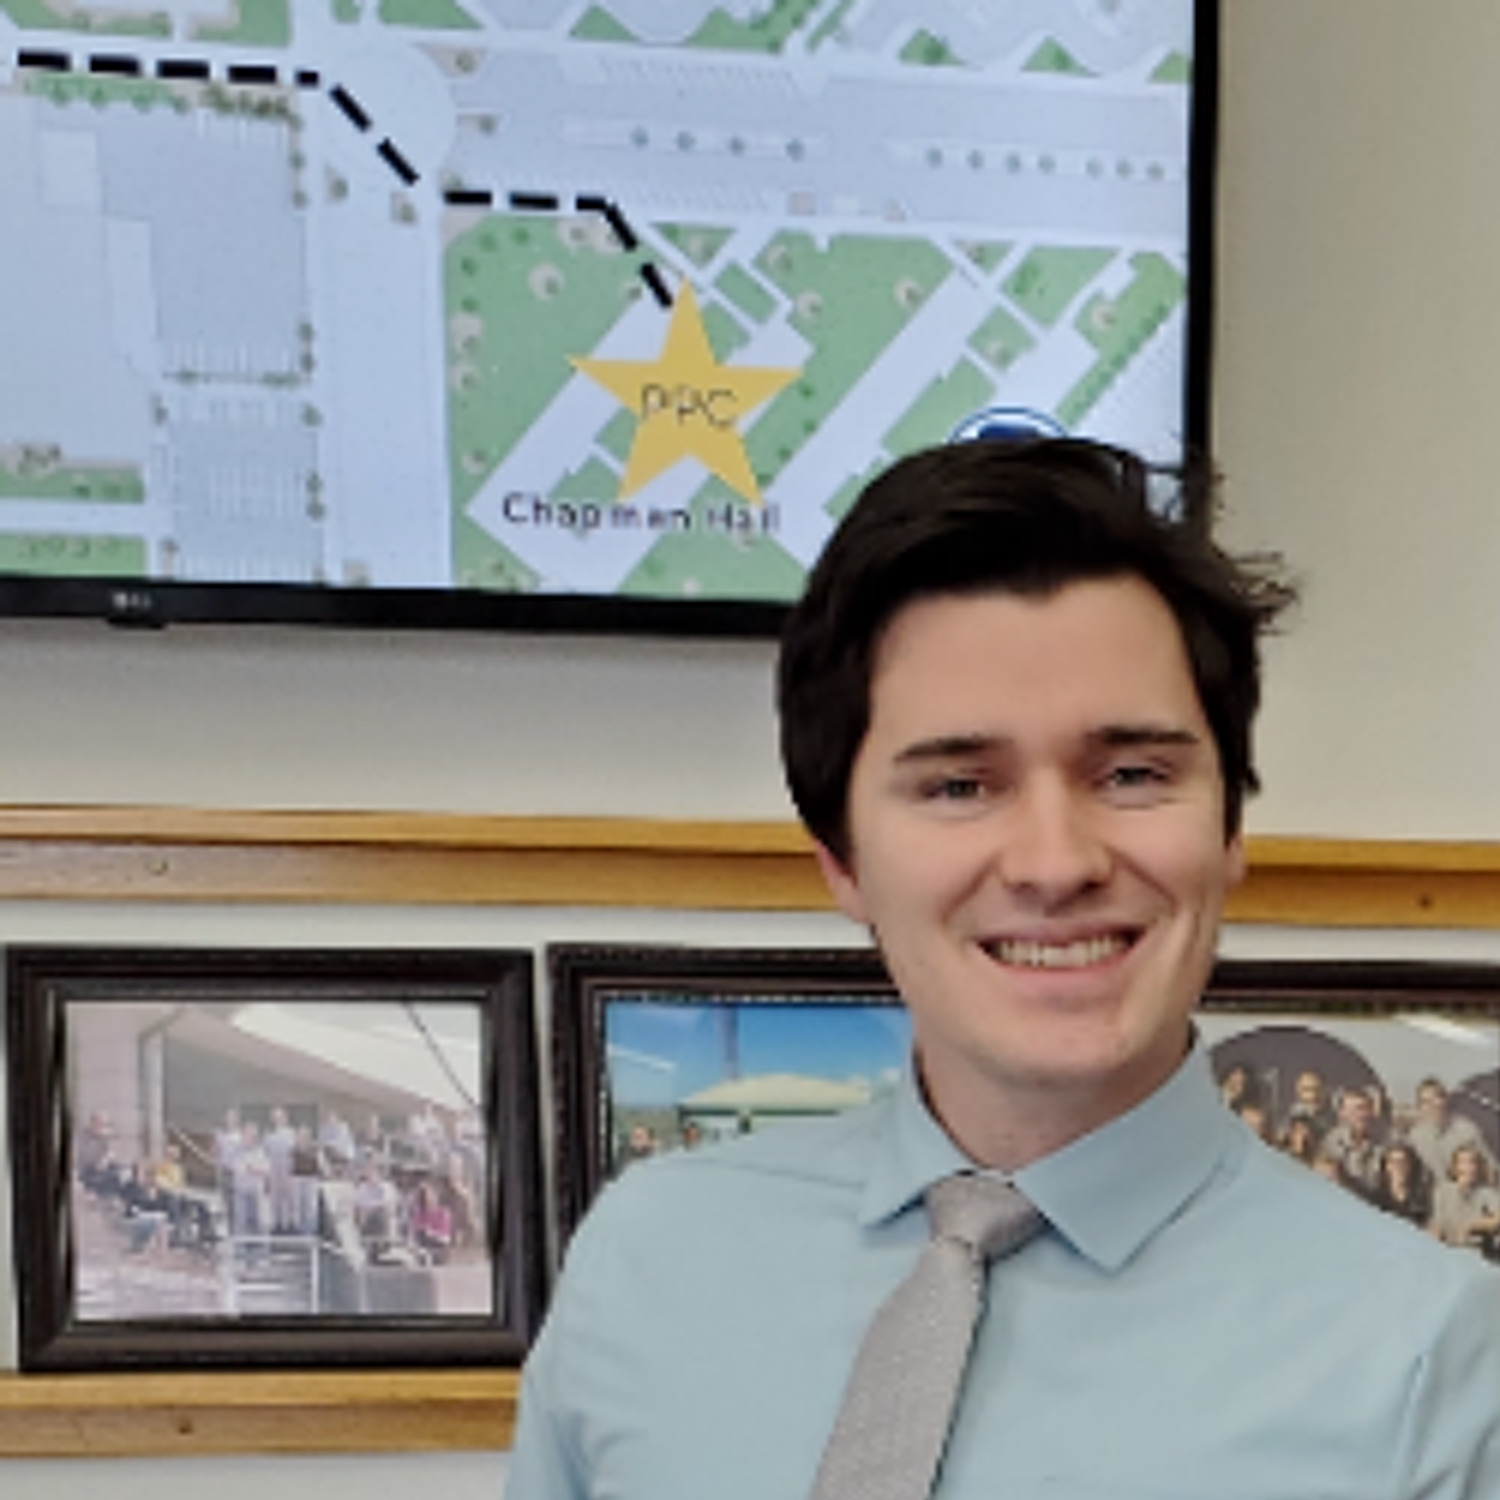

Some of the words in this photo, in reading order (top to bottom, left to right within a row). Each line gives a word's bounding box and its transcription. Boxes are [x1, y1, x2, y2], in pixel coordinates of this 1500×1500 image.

[641, 383, 738, 431] PPC
[502, 490, 692, 530] Chapman
[707, 502, 780, 533] Hall
